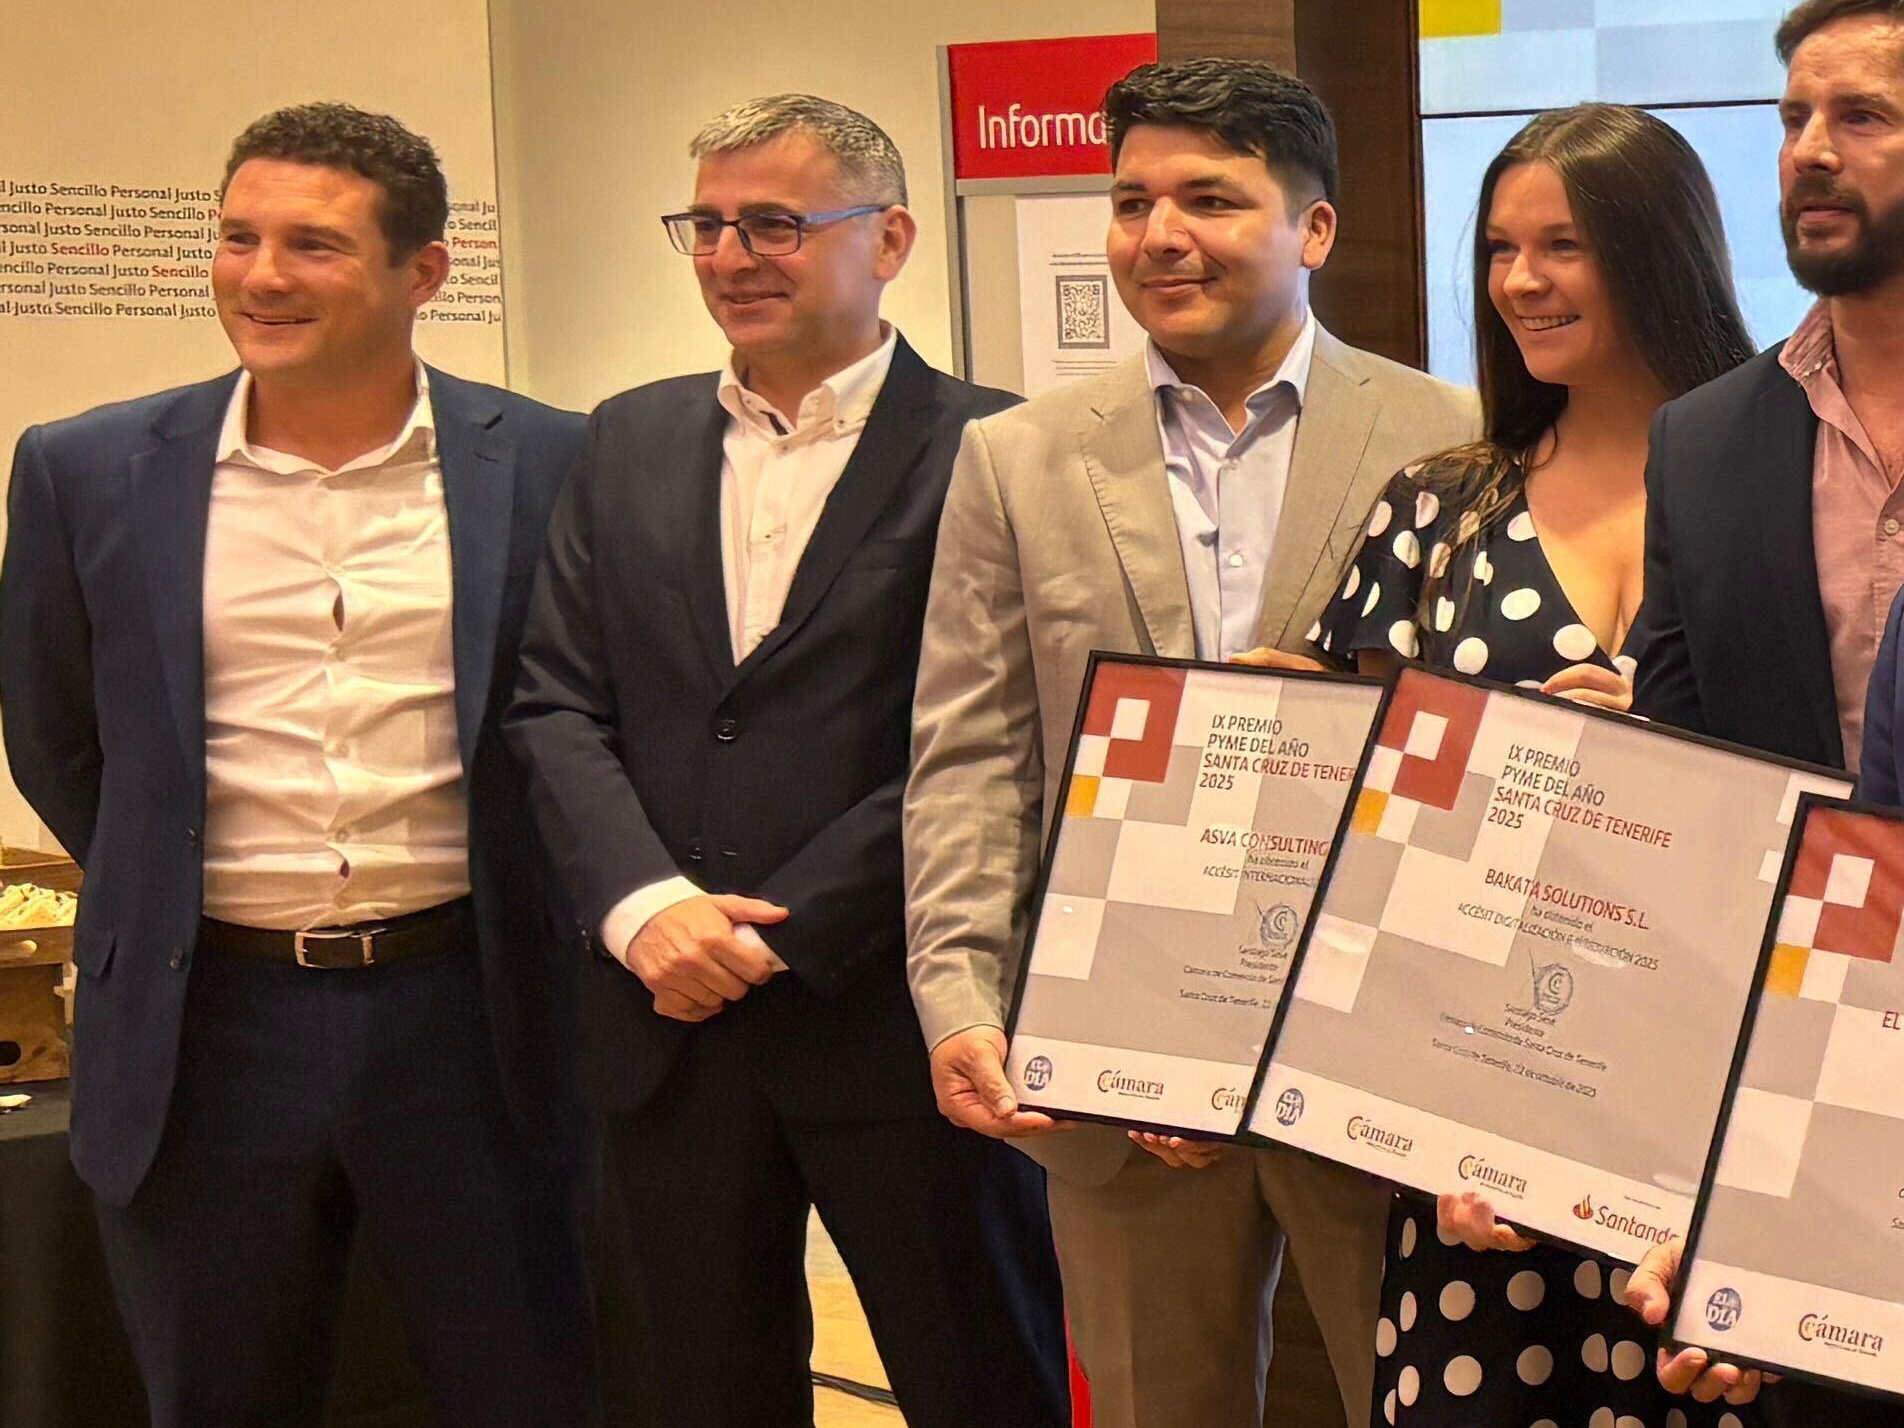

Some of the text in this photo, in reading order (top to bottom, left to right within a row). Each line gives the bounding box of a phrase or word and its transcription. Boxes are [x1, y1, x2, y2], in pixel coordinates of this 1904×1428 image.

[979, 103, 1108, 149] Informa
[9, 181, 211, 203] Justo Sencillo Personal Justo
[45, 202, 205, 222] Personal Justo Sencillo
[44, 221, 204, 240] Justo Sencillo Personal
[10, 240, 212, 261] Justo Sencillo Personal Justo
[47, 262, 209, 279] Personal Justo Sencillo
[50, 282, 209, 298] Justo Sencillo Personal
[55, 303, 112, 316] Sencillo
[116, 304, 176, 317] Personal
[180, 305, 216, 319] Justo
[1212, 715, 1282, 735] IX PREMIO
[1208, 733, 1309, 758] PYME DEL AÑO
[1203, 753, 1248, 772] SANTA
[1252, 758, 1288, 775] CRUZ
[1290, 762, 1311, 778] DE
[1508, 744, 1580, 777] IX PREMIO
[1199, 773, 1235, 790] 2025
[1502, 765, 1605, 806] PYME DEL AÑO
[1488, 807, 1524, 829] 2025
[1494, 786, 1672, 848] SANTA CRUZ DE TENERIFE
[1200, 828, 1237, 846] ASVA
[1542, 885, 1626, 921] SOLUTIONS
[1882, 1011, 1901, 1030] EL
